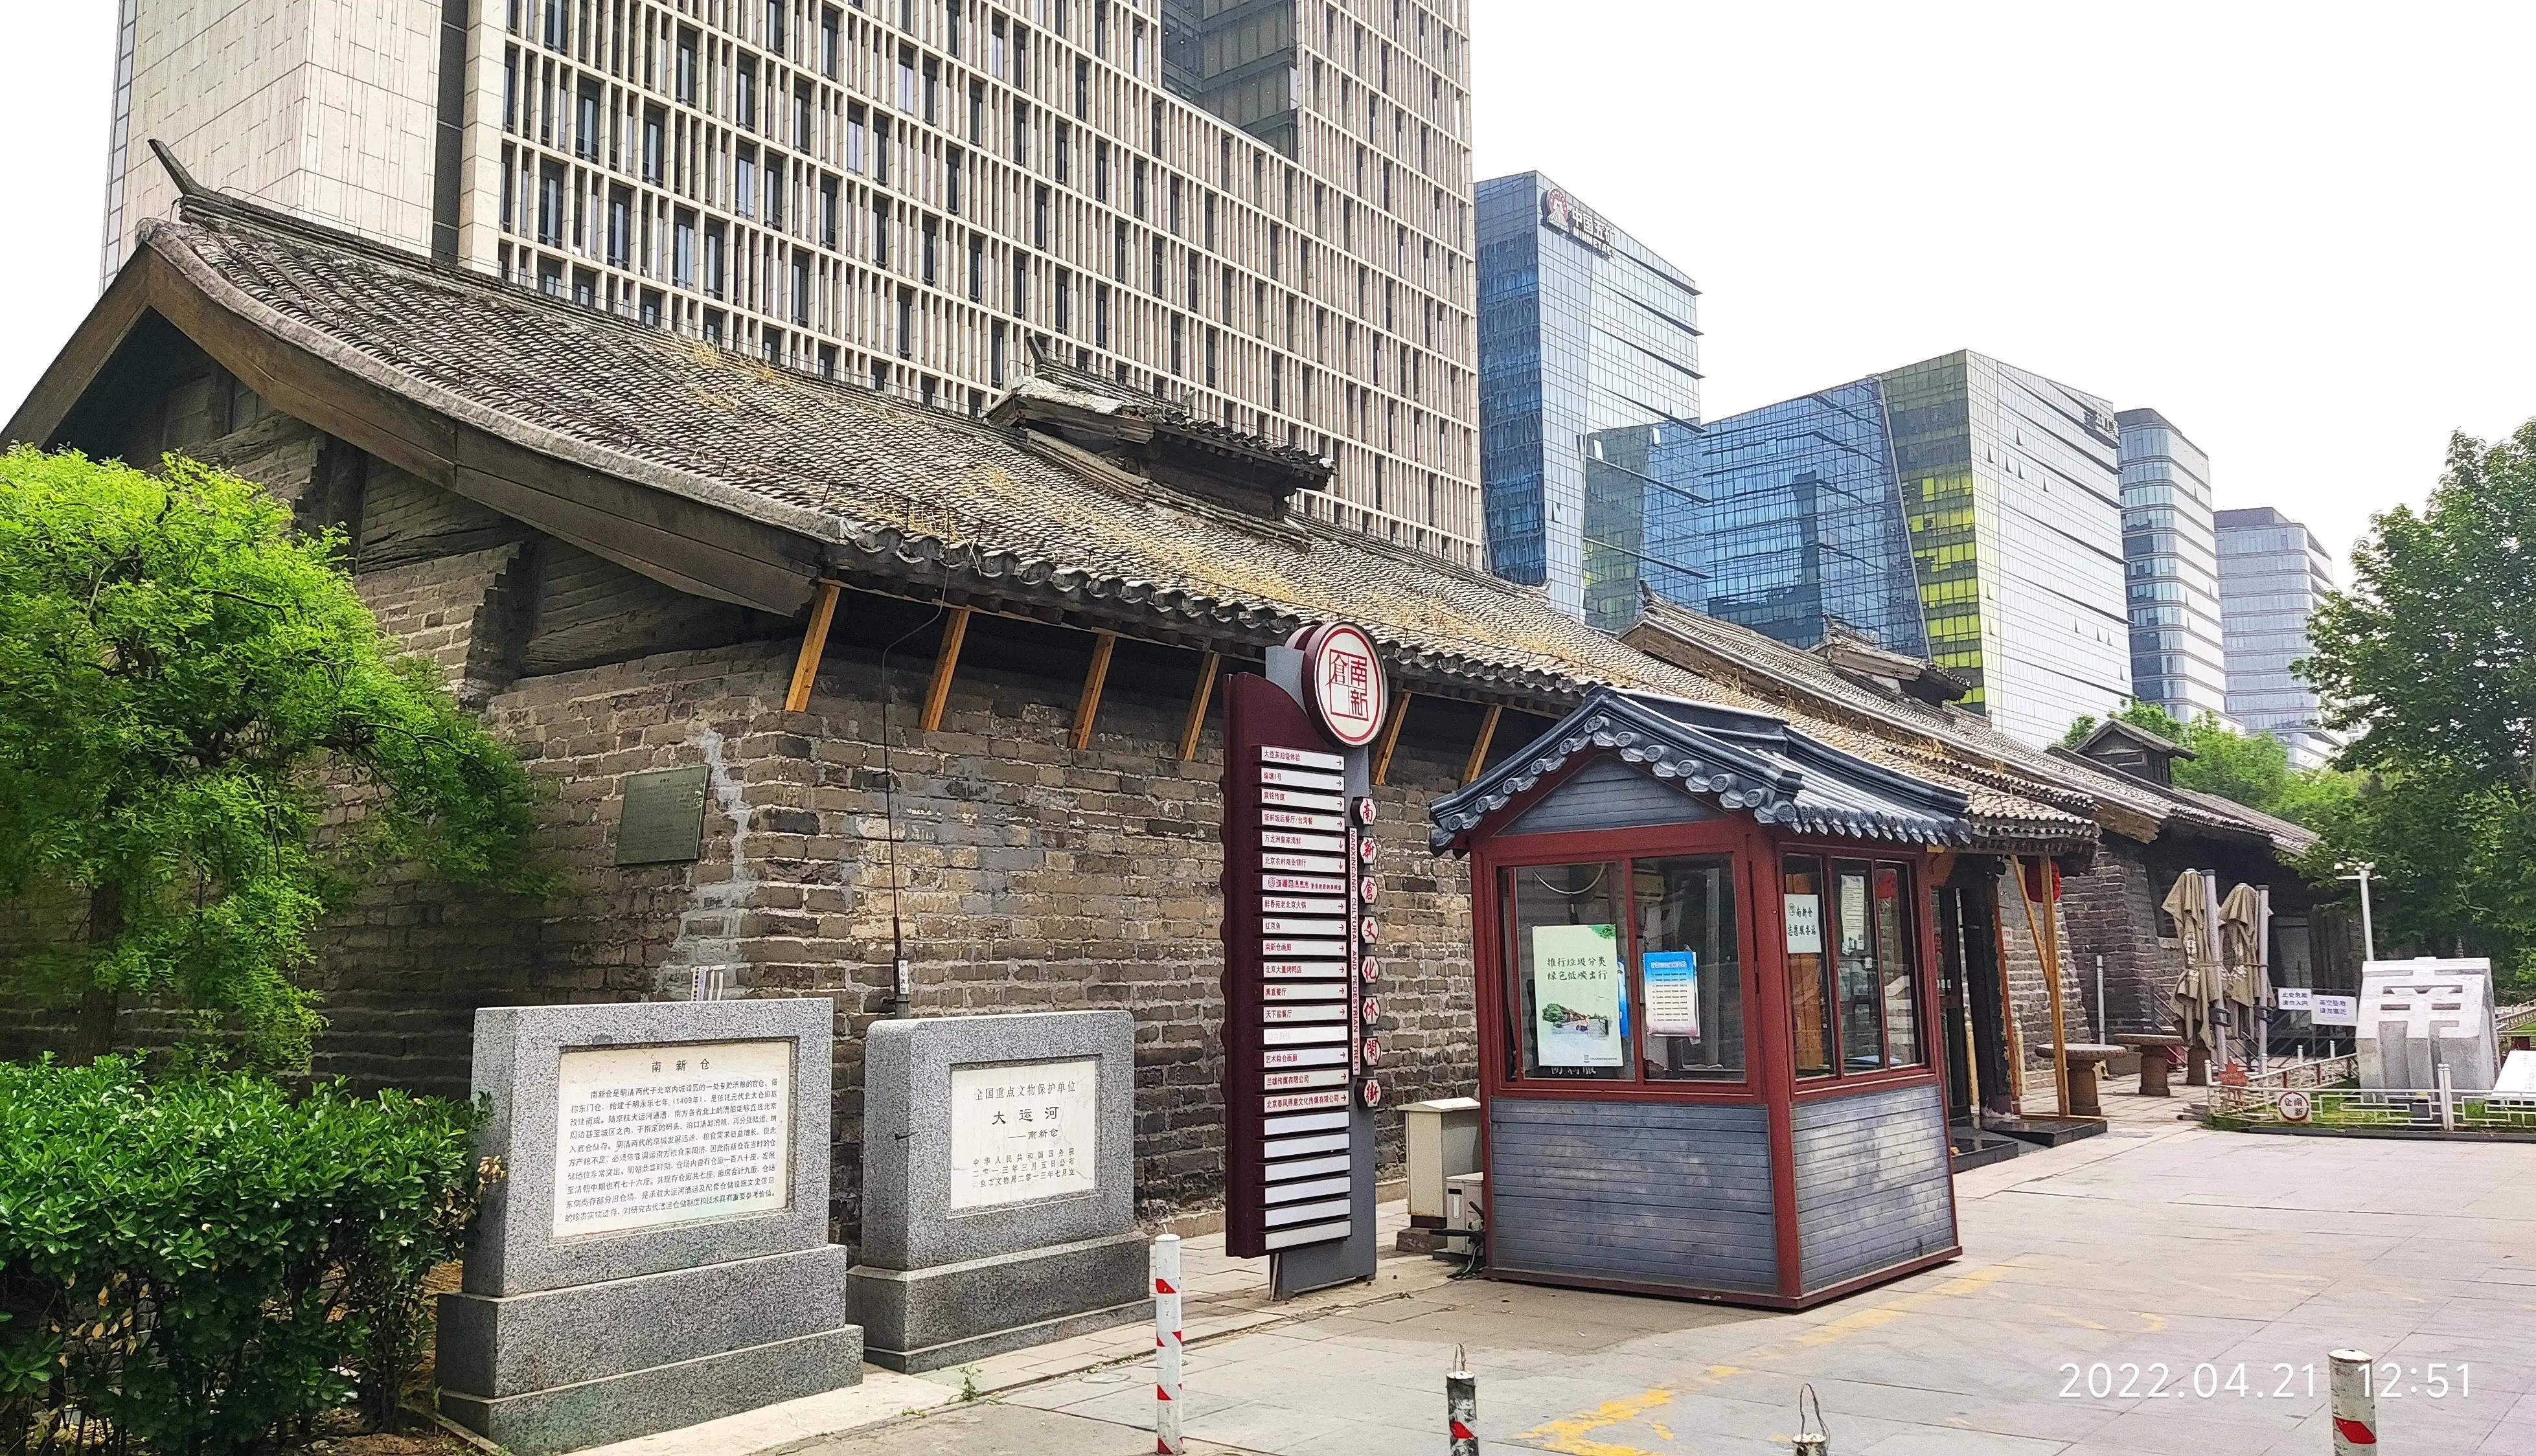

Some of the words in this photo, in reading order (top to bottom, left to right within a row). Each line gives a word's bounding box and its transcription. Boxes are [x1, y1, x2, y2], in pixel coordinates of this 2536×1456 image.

[1572, 207, 1616, 245] 中国五矿
[1573, 226, 1616, 258] MINMETALS
[1265, 857, 1307, 867] 北京农村商业银行
[1265, 943, 1291, 951] 南新仓画廊
[1547, 955, 1607, 968] 推行垃圾分类
[1547, 970, 1608, 981] 绿色低碳出行
[650, 1058, 711, 1074] 南新仓
[974, 1080, 1077, 1101] 全国重点文物保护单位
[992, 1106, 1060, 1125] 大运河
